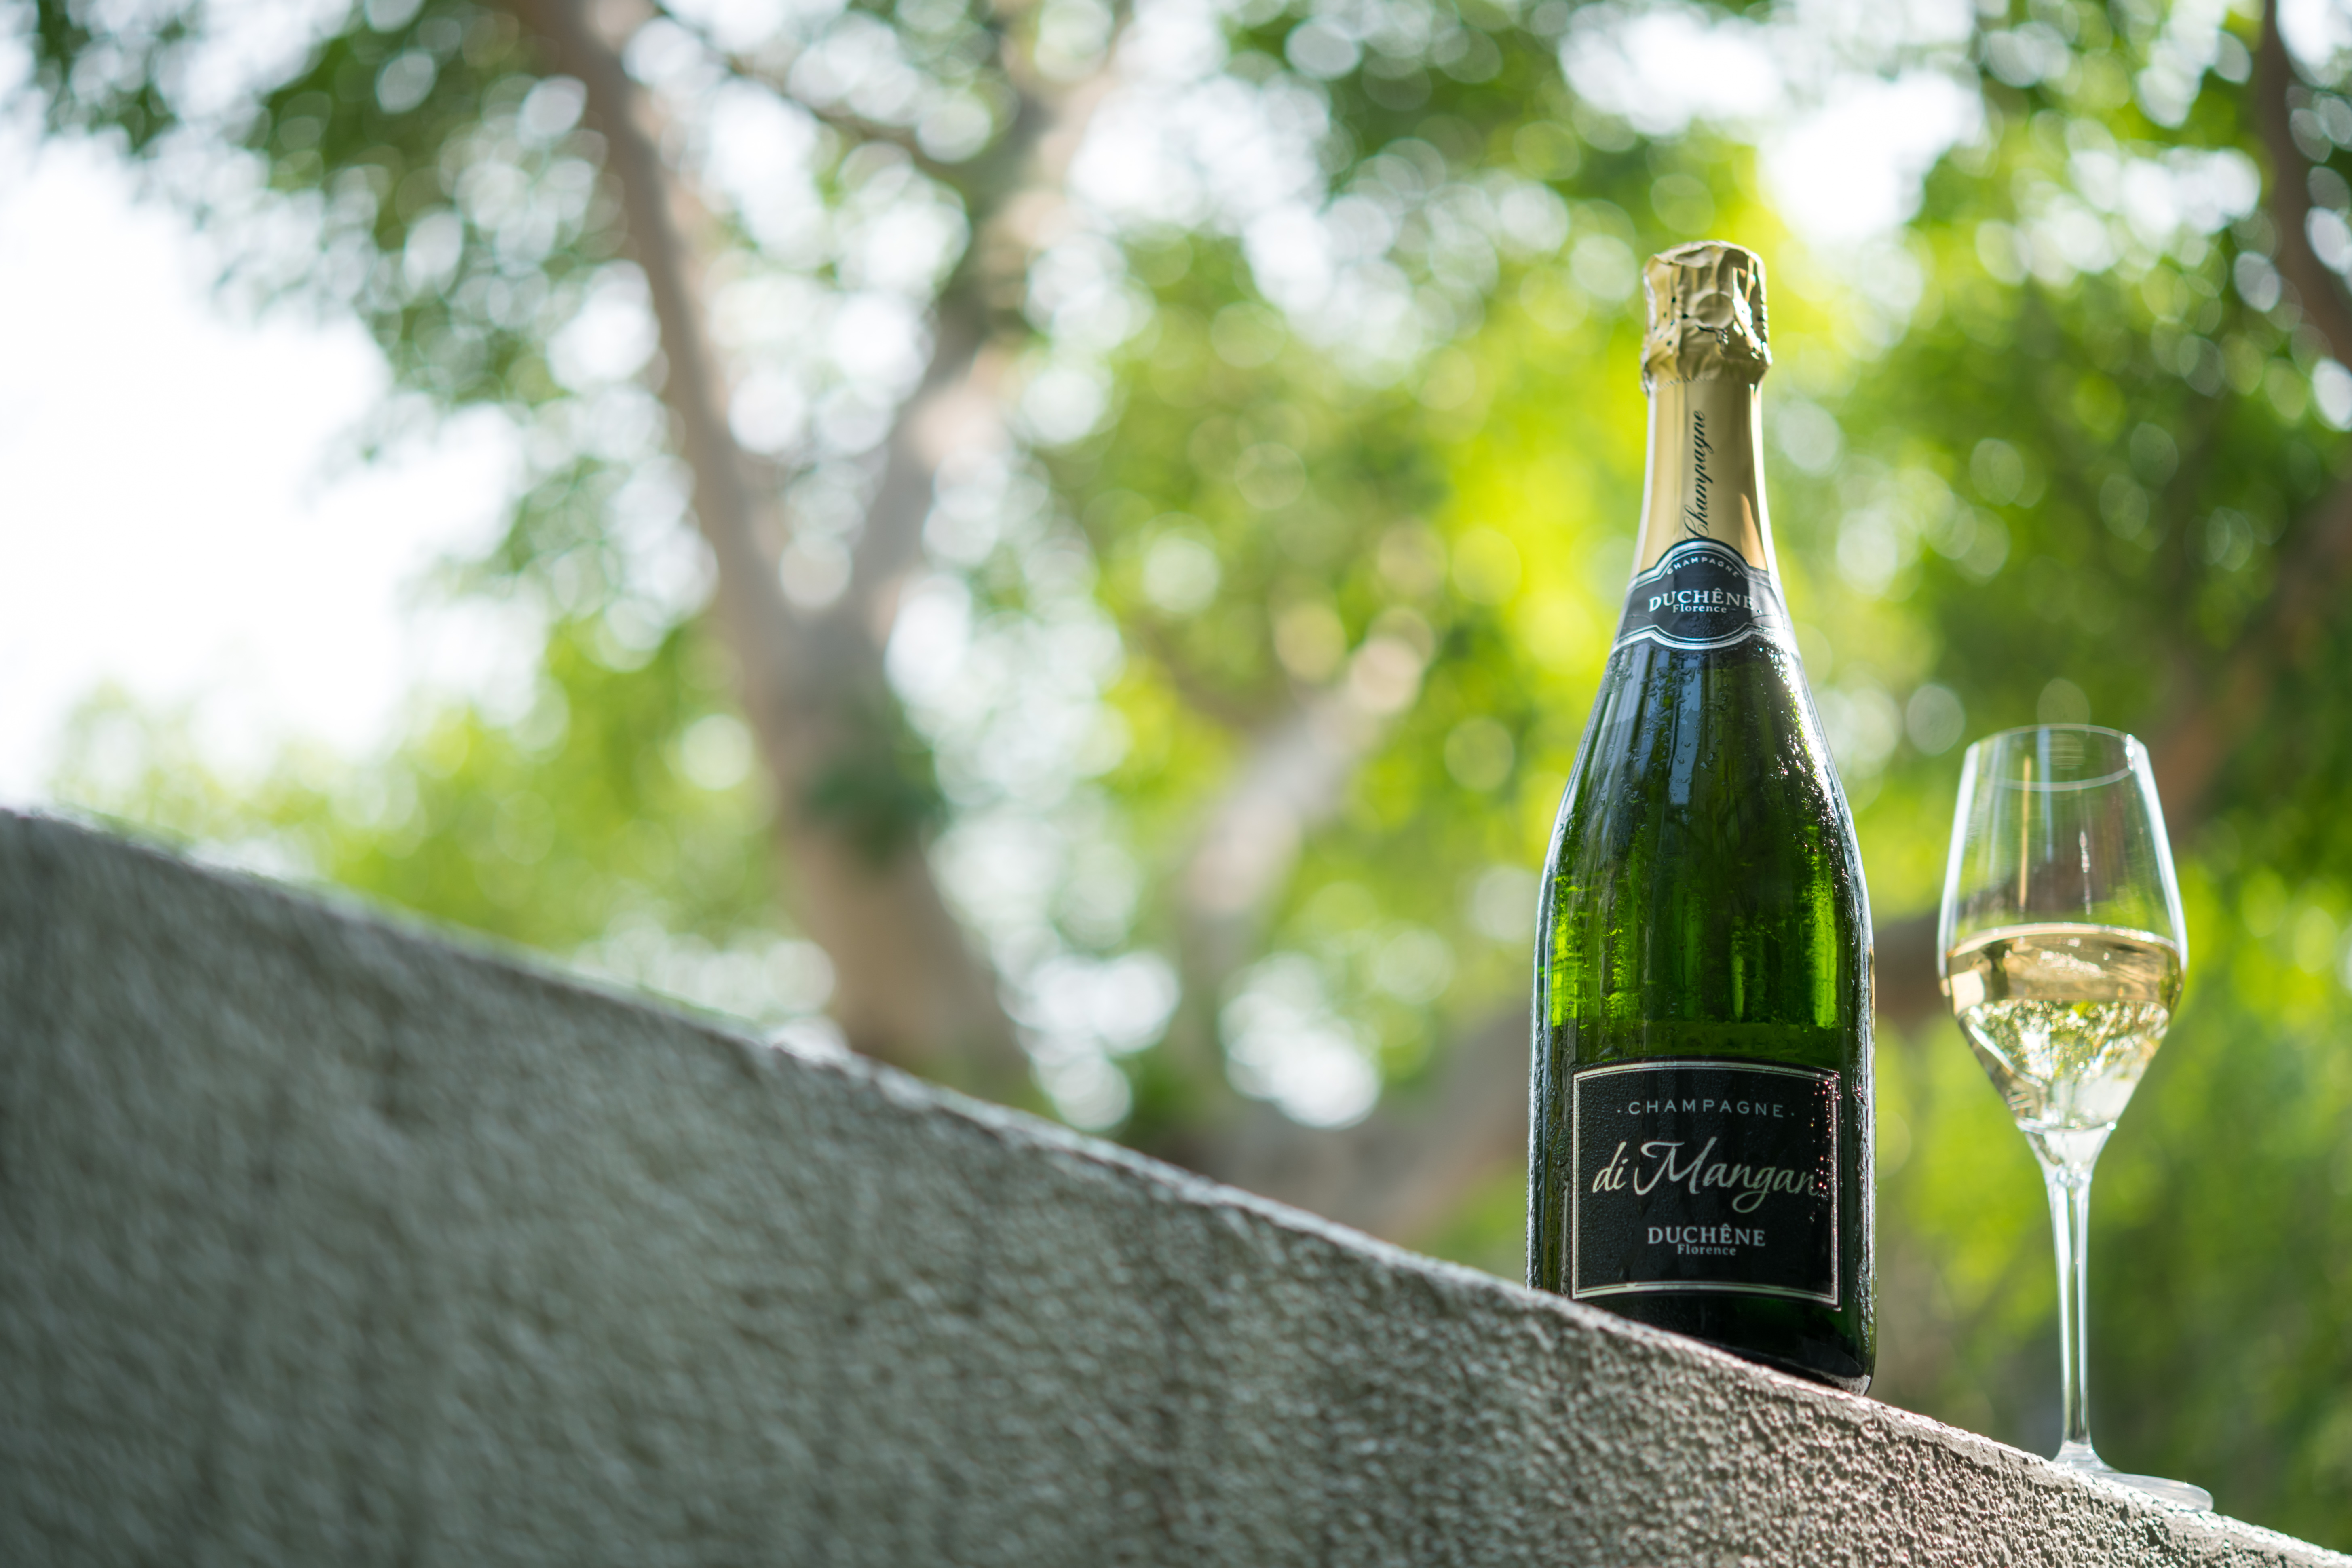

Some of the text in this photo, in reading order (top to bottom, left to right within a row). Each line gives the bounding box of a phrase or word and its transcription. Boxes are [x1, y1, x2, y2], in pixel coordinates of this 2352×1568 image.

[1683, 410, 1714, 540] Champagne
[1666, 556, 1739, 578] CHAMPAGNE
[1648, 587, 1754, 612] DUCHÊNE
[1672, 604, 1727, 613] Florence
[1628, 1099, 1784, 1118] CHAMPAGNE
[1592, 1136, 1820, 1213] di Mangan
[1647, 1222, 1766, 1247] DUCHÊNE
[1677, 1243, 1736, 1256] Florence
